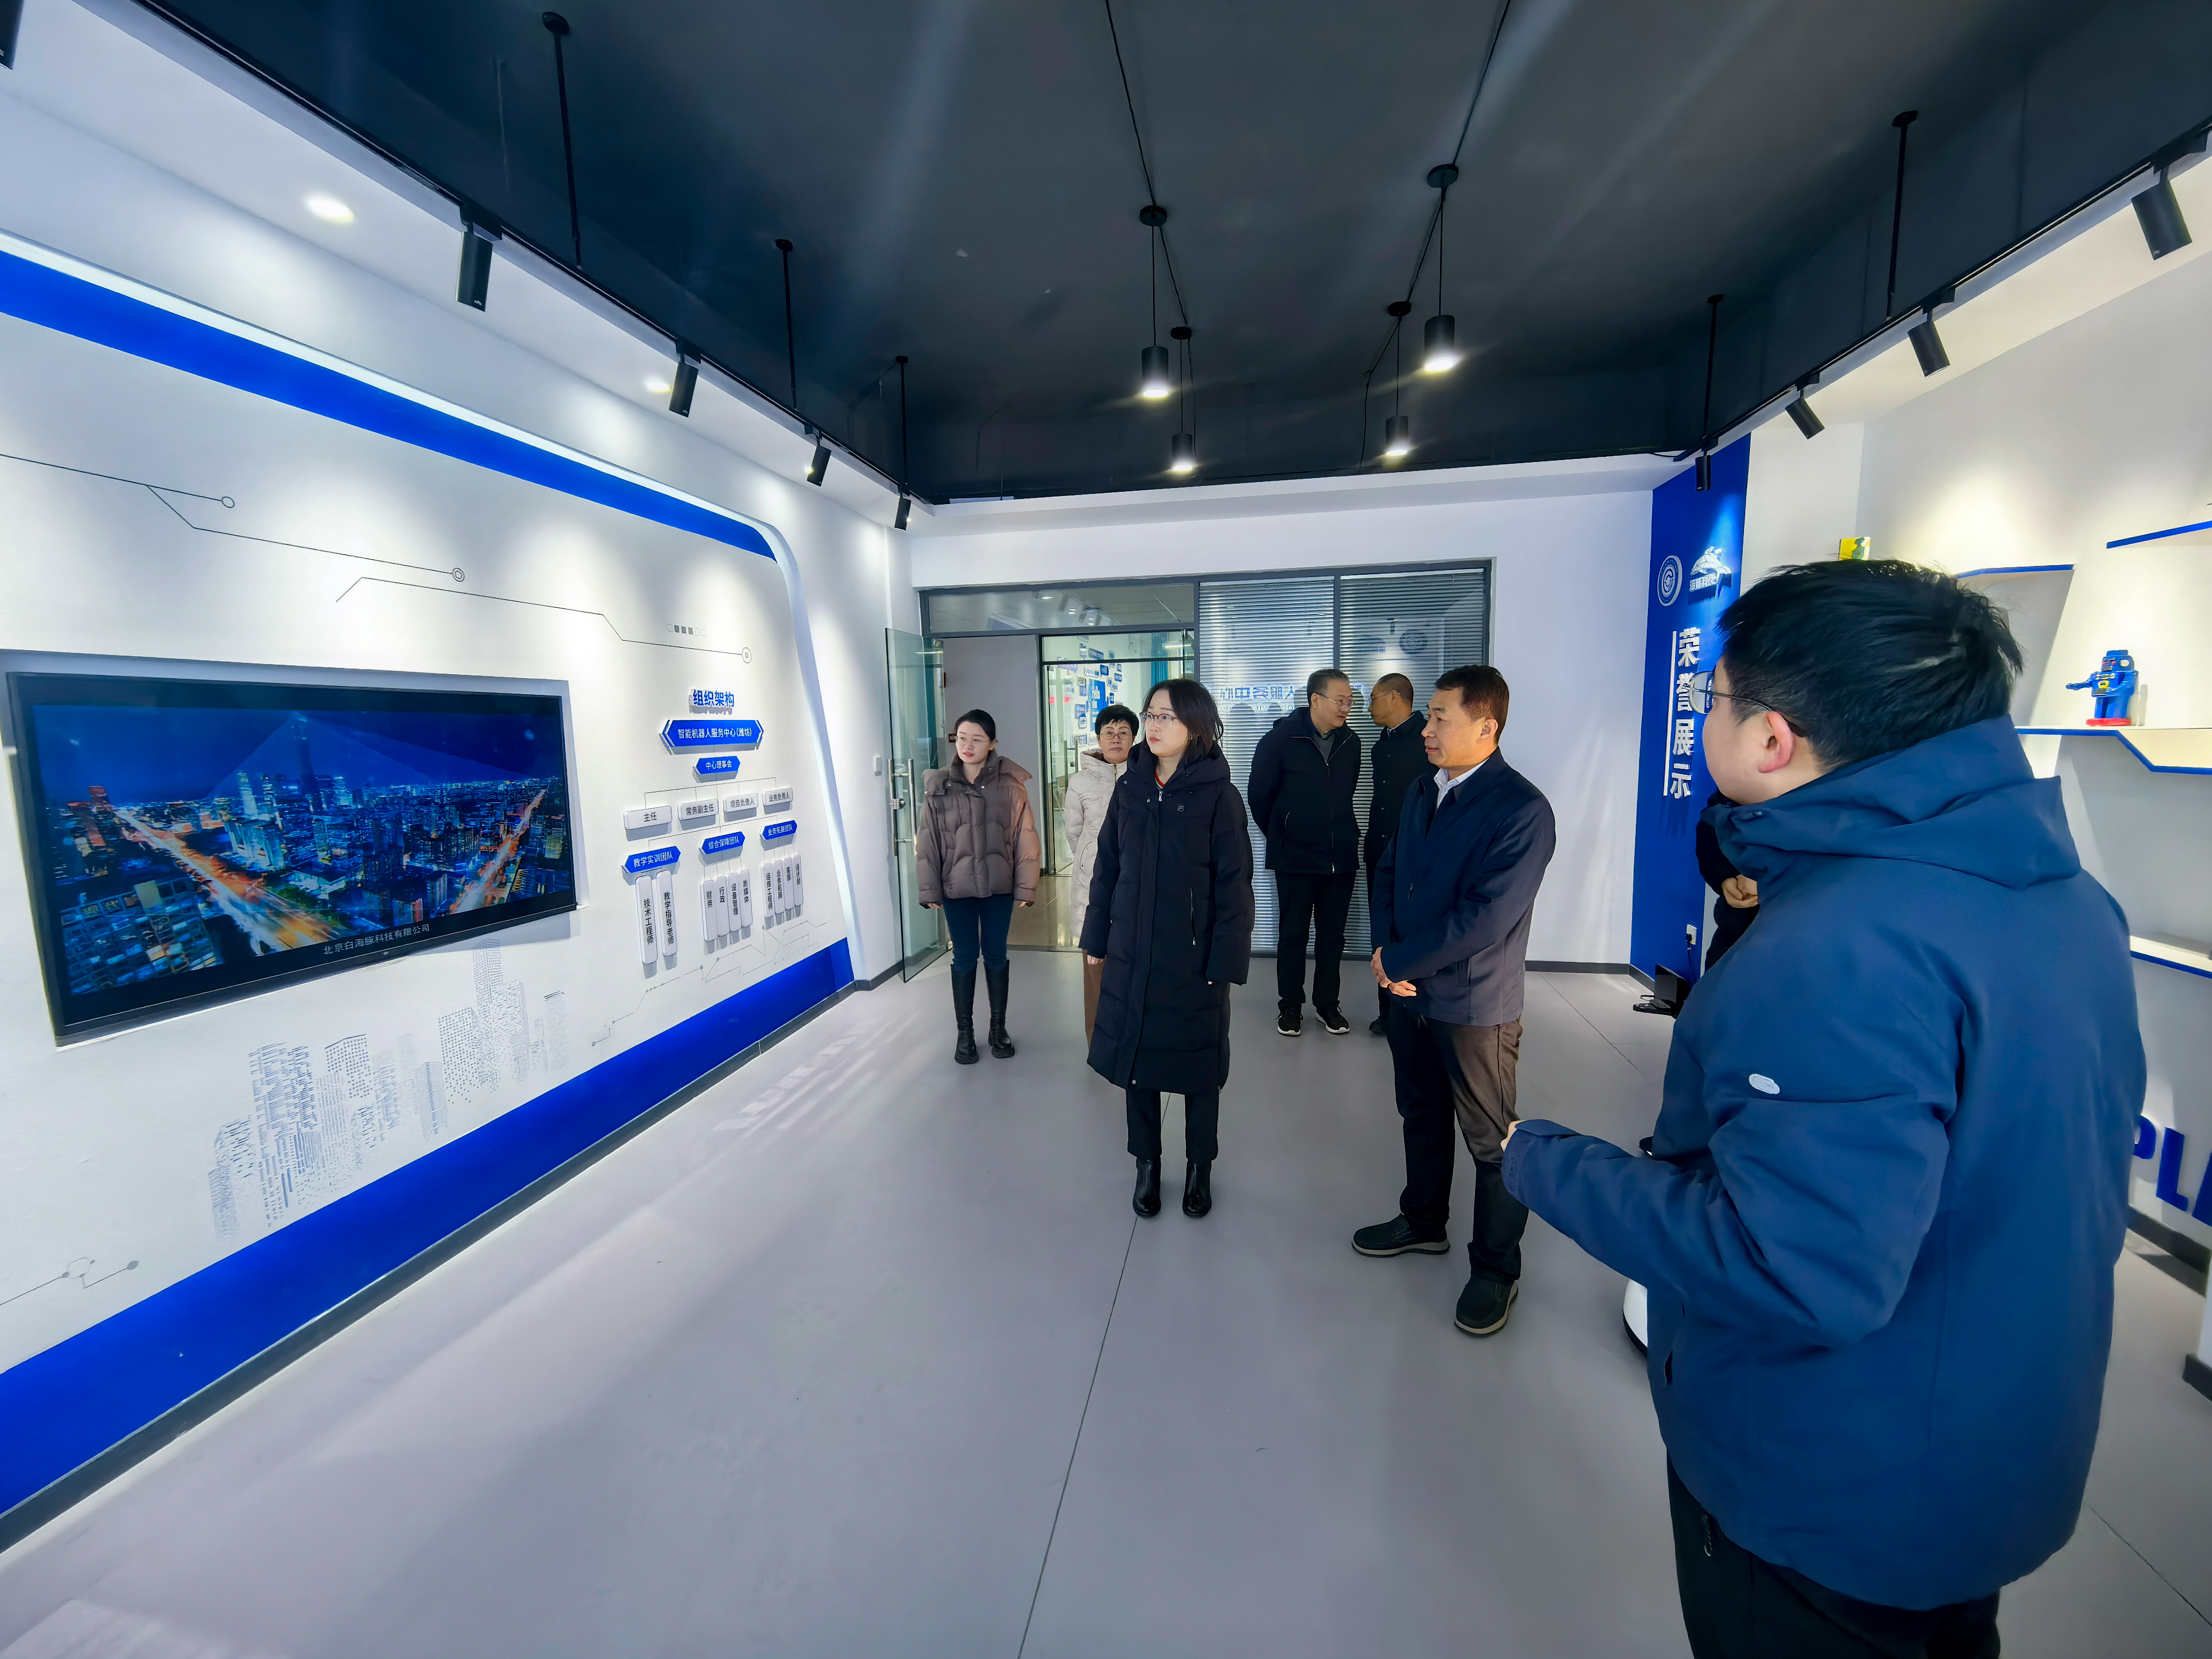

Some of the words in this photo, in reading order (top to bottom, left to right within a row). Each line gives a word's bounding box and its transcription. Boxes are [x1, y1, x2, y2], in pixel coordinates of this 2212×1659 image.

[693, 689, 735, 708] 组织架构
[1670, 627, 1701, 799] 荣誉展示
[706, 760, 732, 769] 中心理事会
[686, 803, 714, 816] 常务副主任
[730, 797, 755, 808] 项目负责人
[643, 811, 657, 822] 主任
[708, 835, 740, 850] 综合保障团队
[633, 851, 674, 868] 教学实训团队
[643, 898, 653, 945] 技术工程师
[323, 924, 430, 955] 北京白海豚科技有限公司
